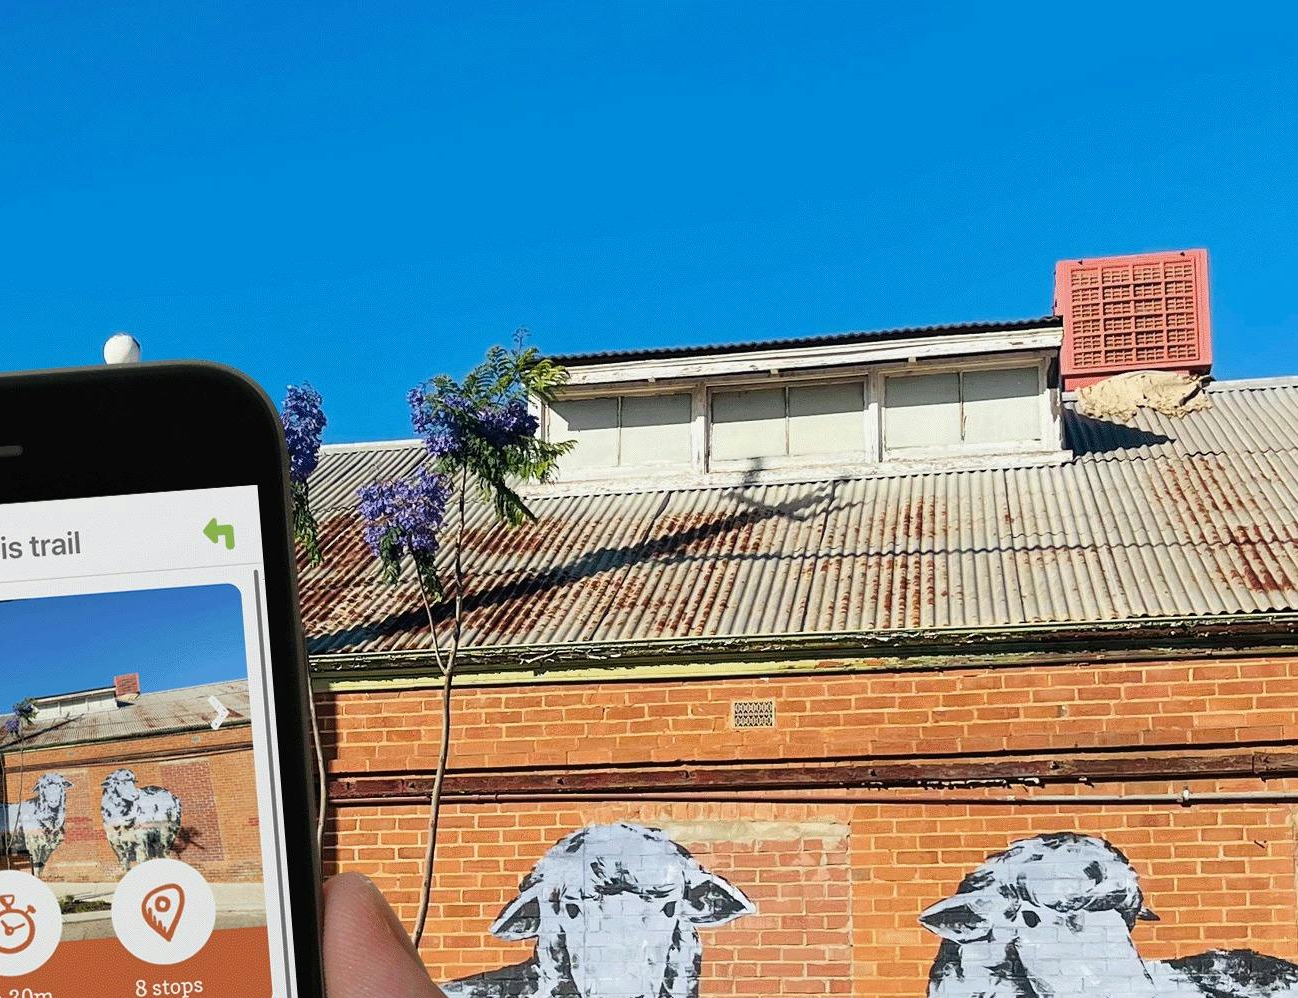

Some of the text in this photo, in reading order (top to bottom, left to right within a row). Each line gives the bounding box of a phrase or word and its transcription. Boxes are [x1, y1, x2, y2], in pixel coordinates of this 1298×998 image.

[29, 530, 81, 557] trail
[135, 979, 203, 998] 8 stops
